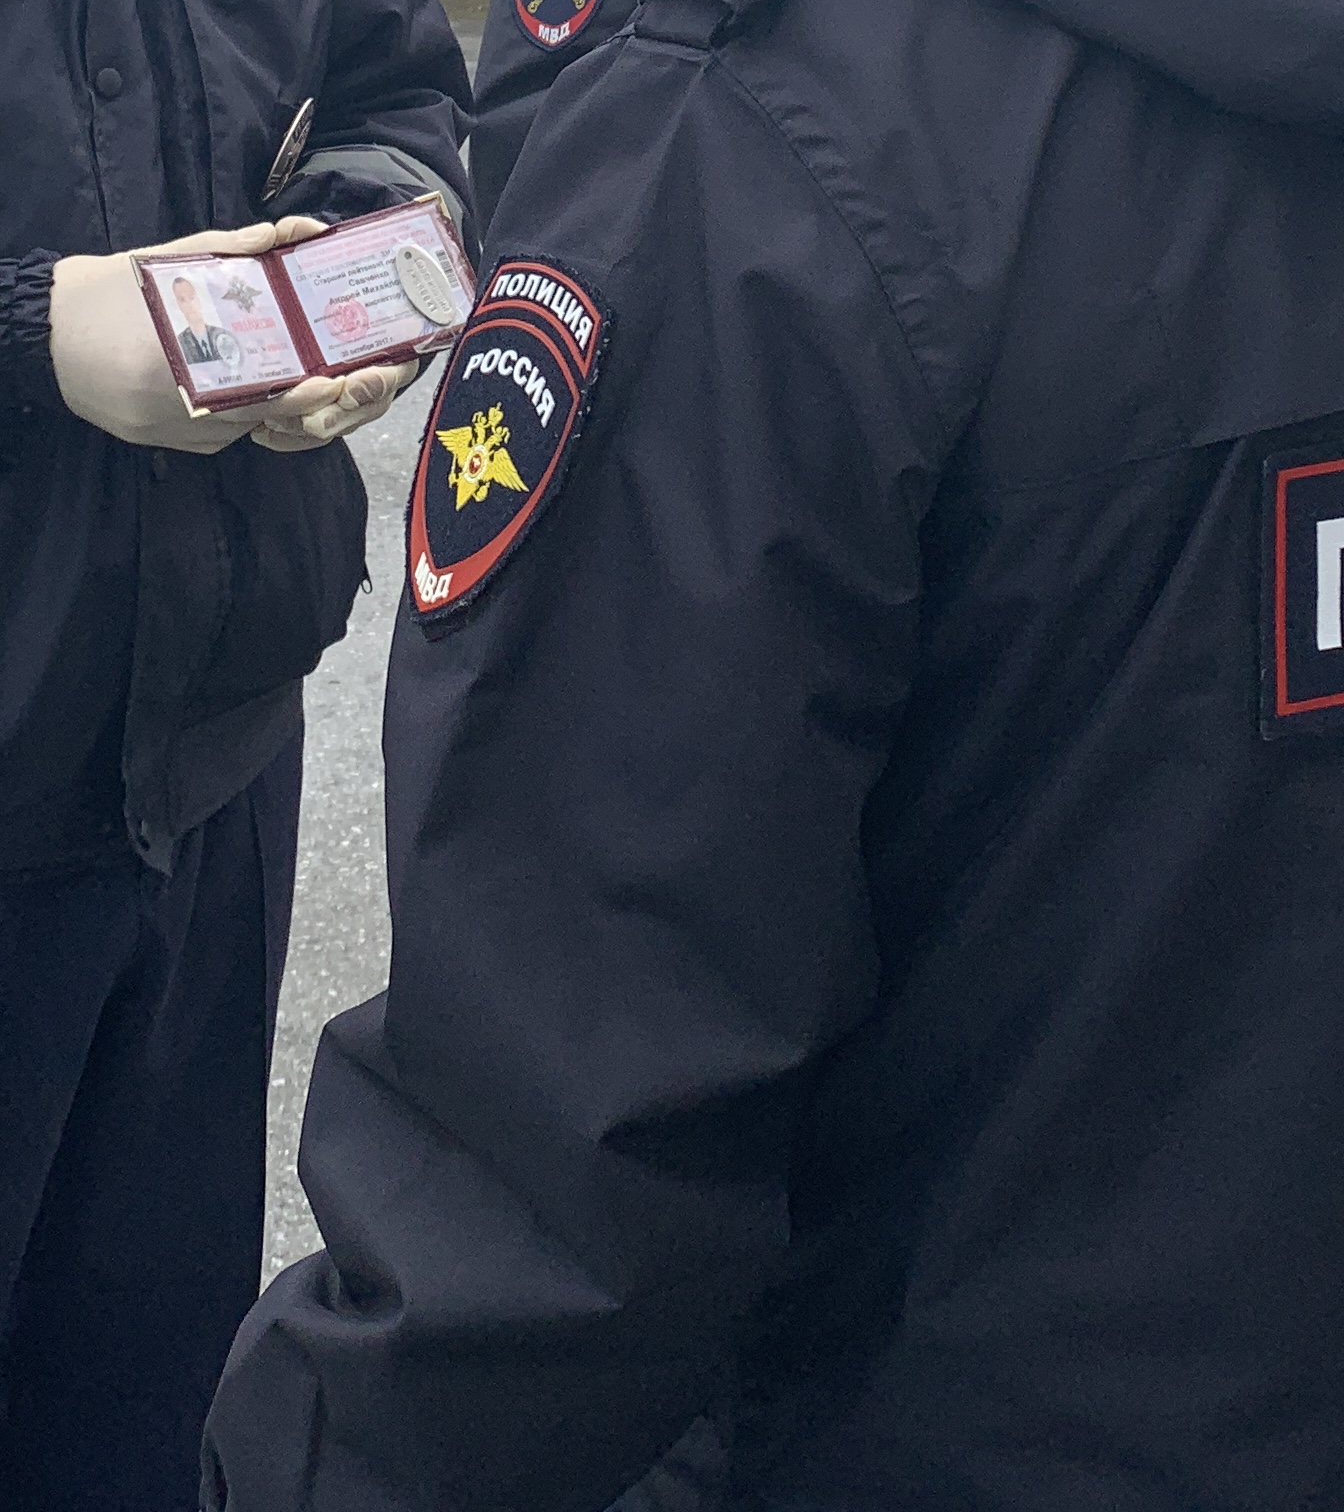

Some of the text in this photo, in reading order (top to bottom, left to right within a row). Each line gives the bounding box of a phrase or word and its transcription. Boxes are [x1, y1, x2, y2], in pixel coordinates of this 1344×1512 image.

[538, 21, 570, 44] МВД
[361, 277, 401, 295] Михайло
[488, 273, 595, 350] ПОЛИЦИЯ
[461, 347, 556, 428] РОССИЯ
[414, 551, 454, 604] МВД
